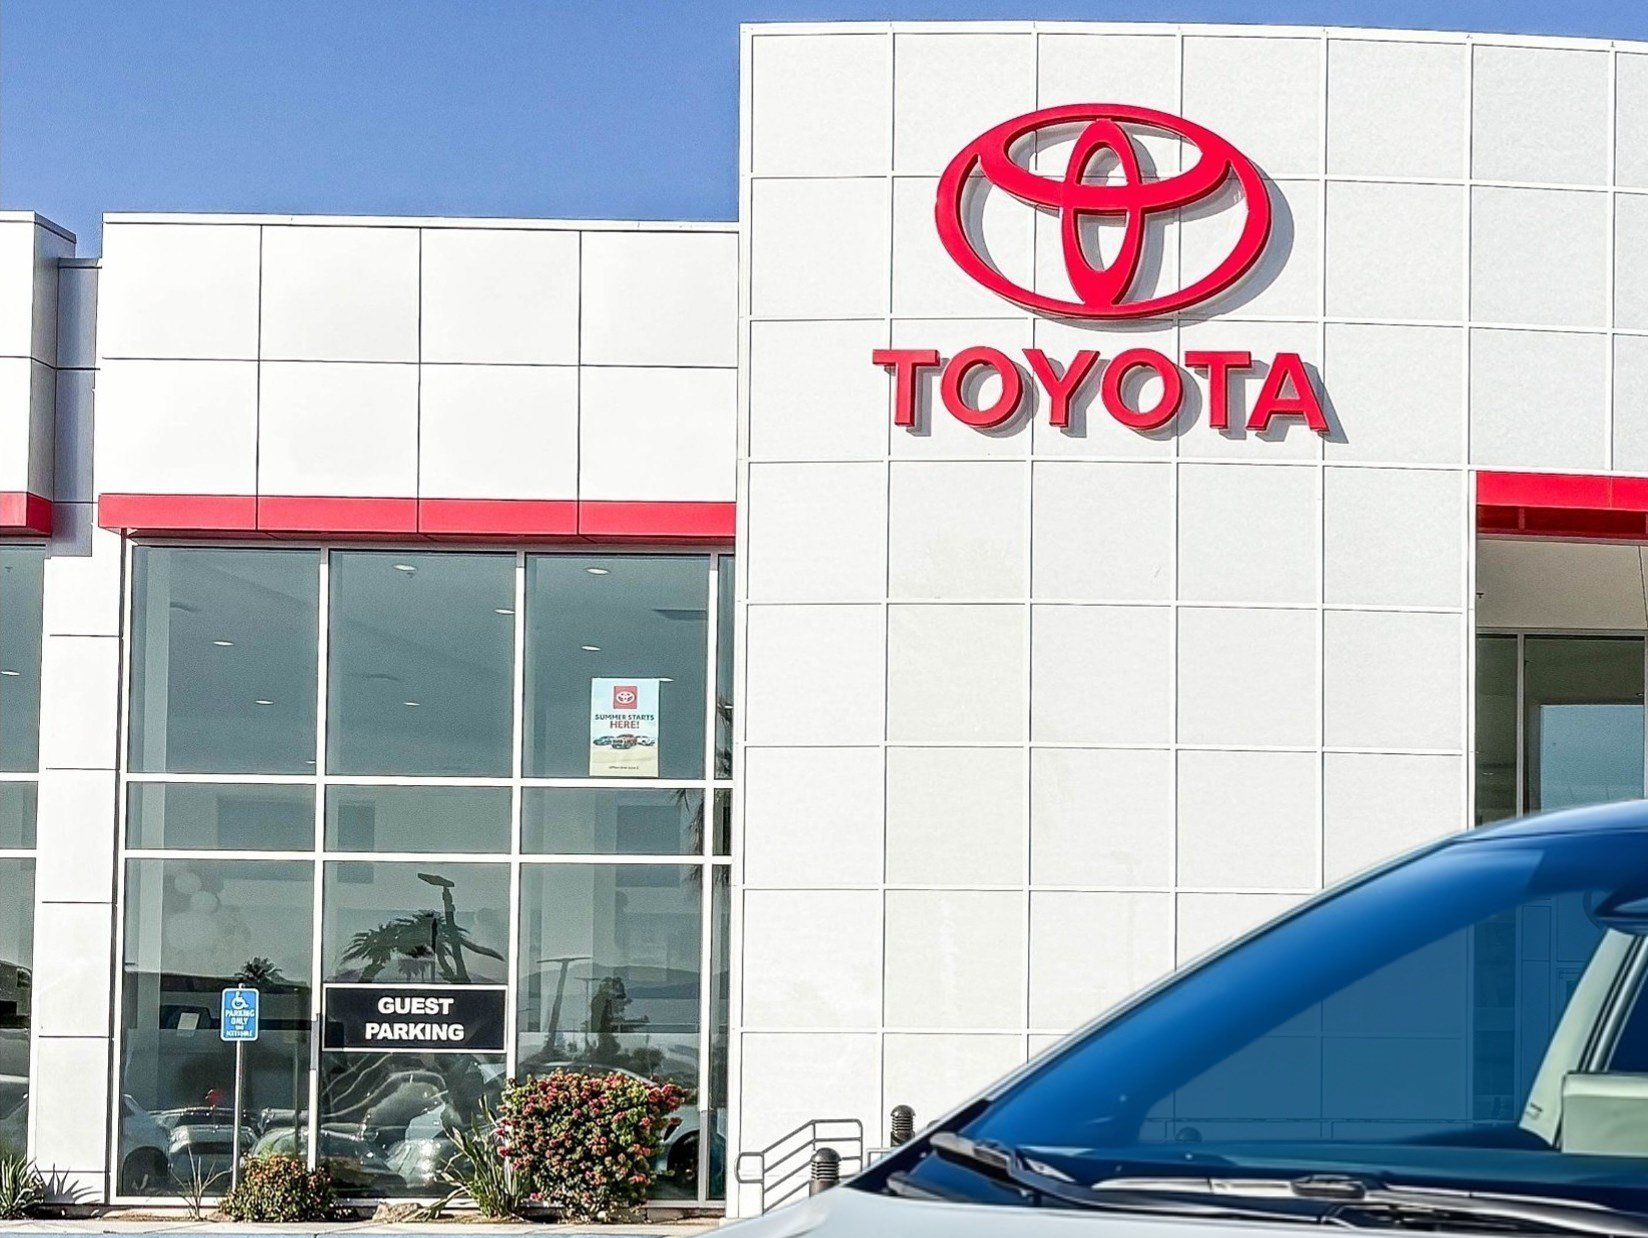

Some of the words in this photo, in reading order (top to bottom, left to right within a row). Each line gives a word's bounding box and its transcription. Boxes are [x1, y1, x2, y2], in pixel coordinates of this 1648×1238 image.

[872, 345, 1329, 435] TOYOTA
[610, 720, 640, 729] HERE!
[377, 997, 454, 1015] GUEST
[365, 1023, 464, 1041] PARKING
